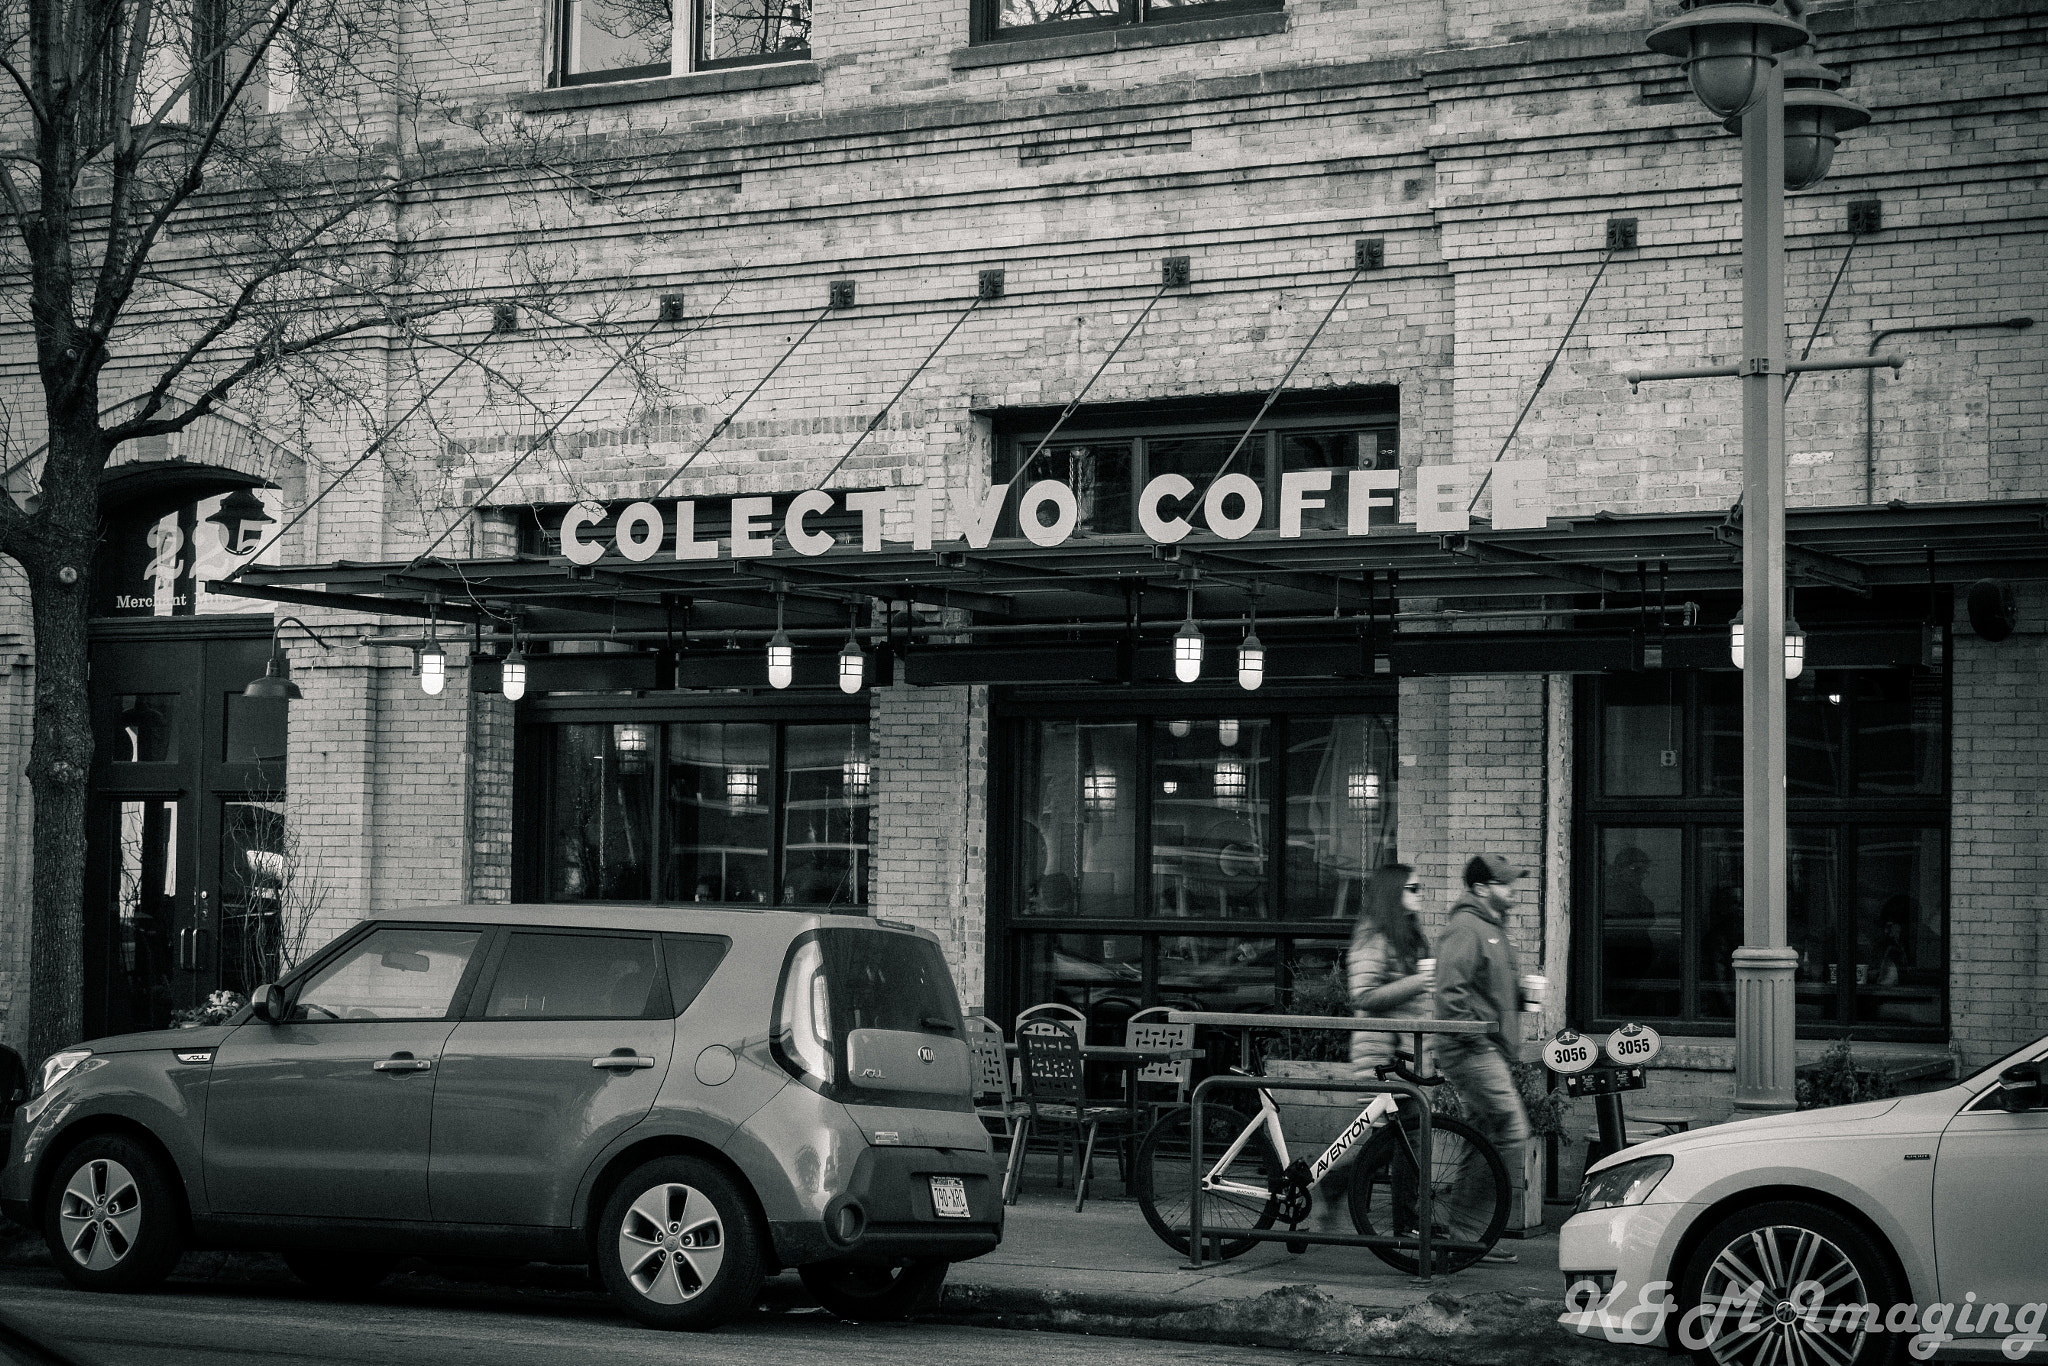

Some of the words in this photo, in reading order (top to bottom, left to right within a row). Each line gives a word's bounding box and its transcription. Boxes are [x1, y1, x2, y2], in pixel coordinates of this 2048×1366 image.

[560, 479, 1077, 565] COLECTIVO
[1138, 459, 1547, 544] COFFEE
[1555, 1047, 1587, 1063] 3056
[1618, 1038, 1650, 1055] 3055
